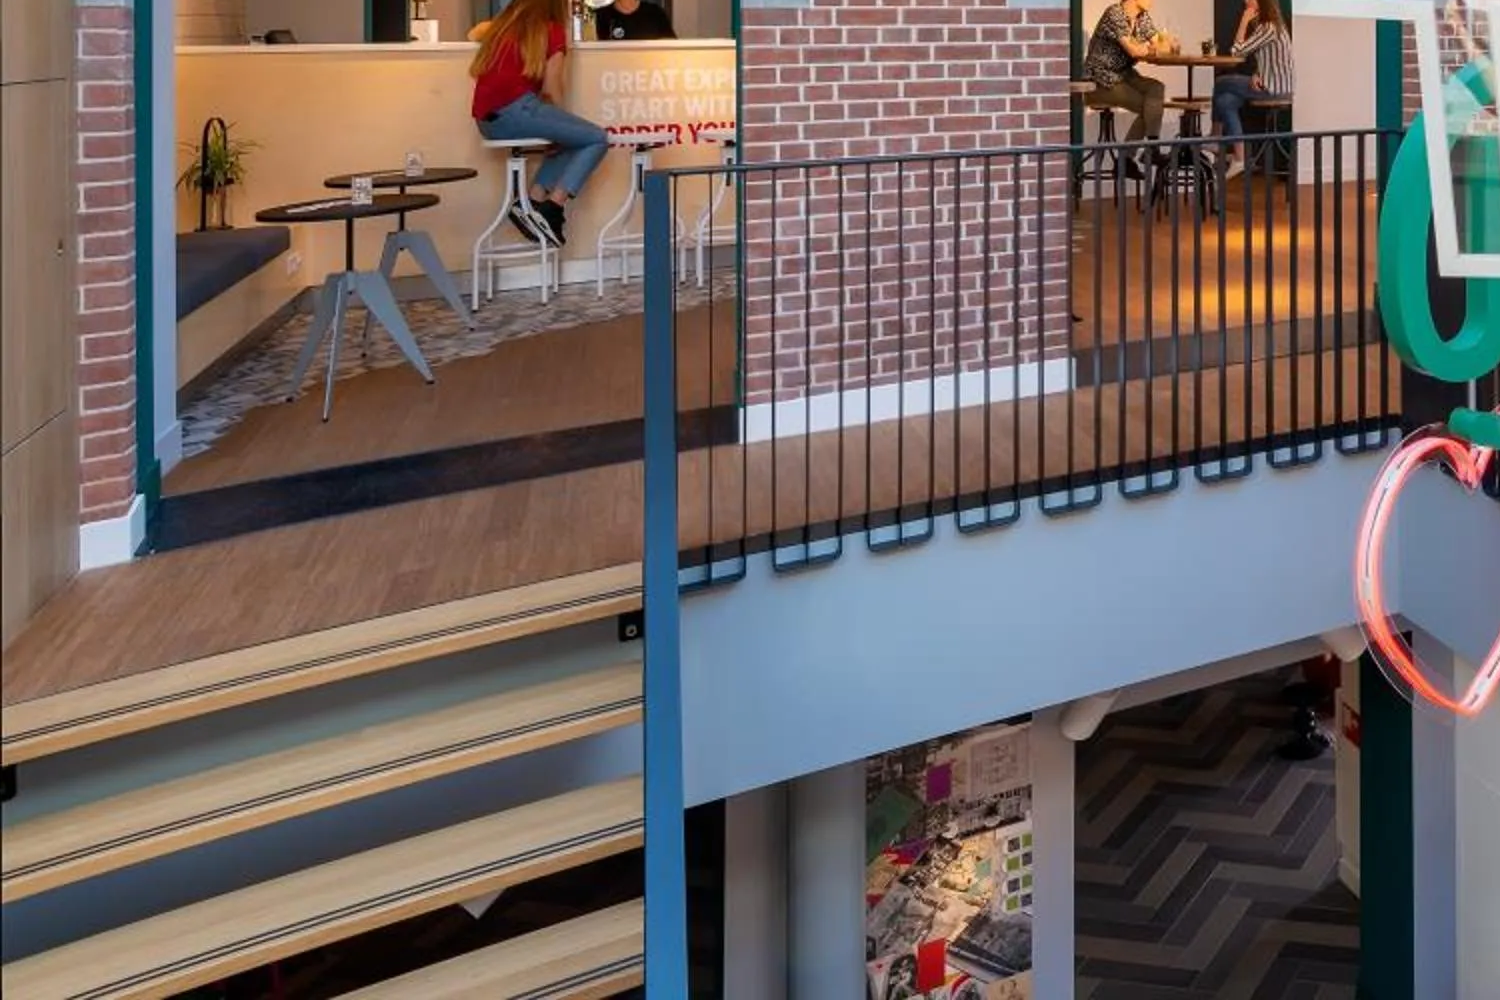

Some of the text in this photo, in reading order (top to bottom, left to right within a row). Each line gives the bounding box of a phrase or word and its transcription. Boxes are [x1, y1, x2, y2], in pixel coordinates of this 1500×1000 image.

[601, 68, 736, 93] GREAT EXP
[602, 93, 736, 120] START WIT
